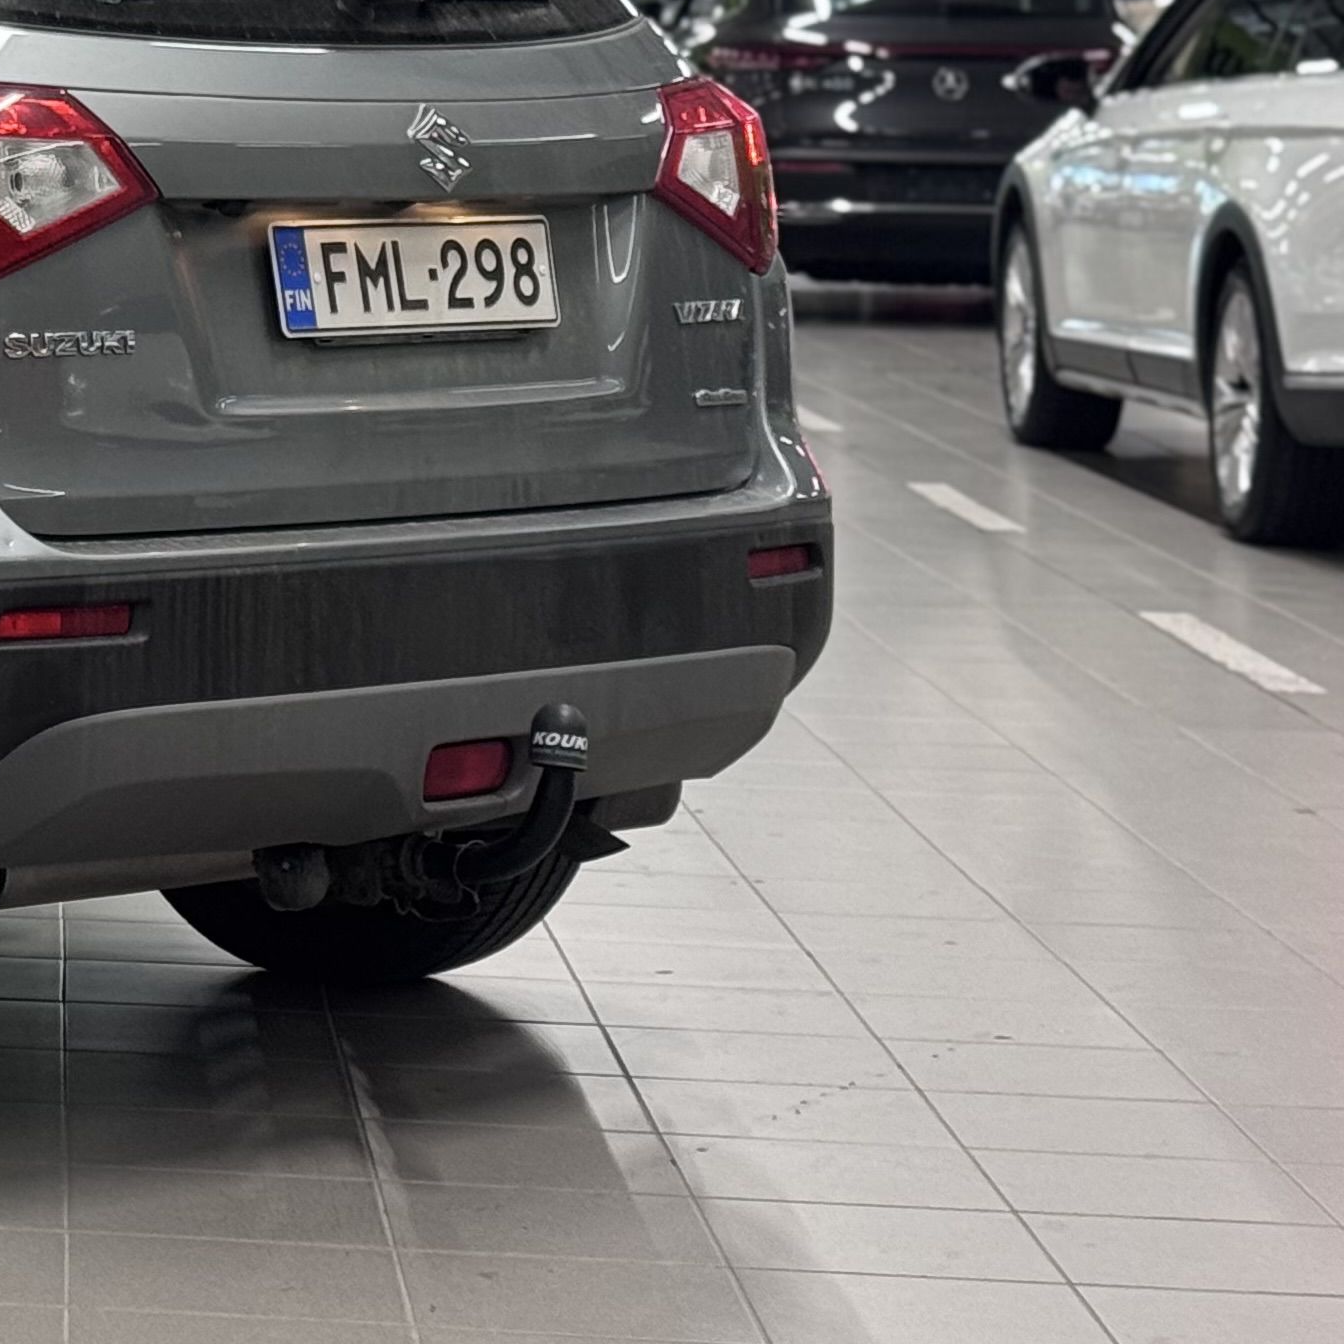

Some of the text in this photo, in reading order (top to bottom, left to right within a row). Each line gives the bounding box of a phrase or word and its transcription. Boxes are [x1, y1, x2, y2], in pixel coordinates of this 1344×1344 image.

[320, 237, 540, 314] FML-298
[284, 289, 312, 312] FIN
[4, 329, 136, 359] SUZUKI
[532, 731, 588, 751] KOUK
